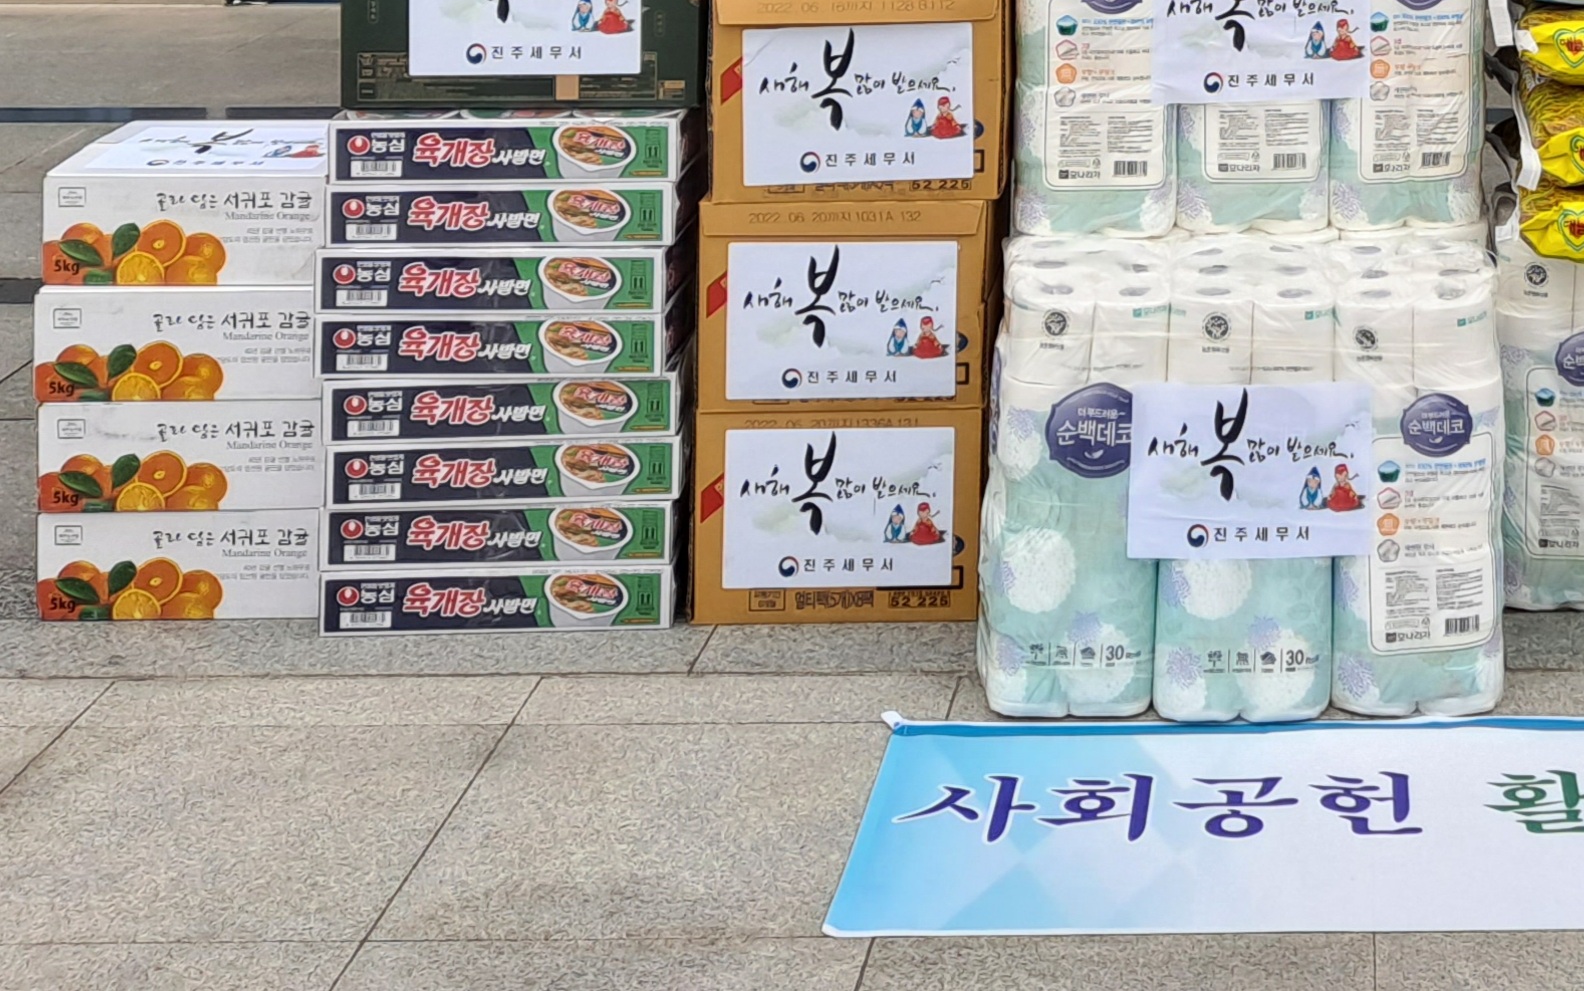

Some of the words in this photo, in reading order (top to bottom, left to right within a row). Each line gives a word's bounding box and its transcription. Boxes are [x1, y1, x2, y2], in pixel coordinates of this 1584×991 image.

[491, 45, 581, 59] 진주세무서
[1228, 72, 1314, 88] 진주세무서
[370, 136, 406, 152] 농심
[411, 131, 495, 168] 육개장
[491, 147, 548, 166] 사발면
[223, 191, 274, 211] 서귀포
[279, 190, 313, 211] 감귤
[365, 200, 401, 216] 농심
[406, 195, 490, 232] 육개장
[486, 211, 543, 230] 사발면
[53, 259, 80, 276] 5kg
[356, 329, 392, 346] 농심
[397, 325, 482, 363] 육개장
[477, 341, 534, 361] 사발면
[367, 395, 404, 412] 농심
[409, 388, 495, 427] 육개장
[491, 403, 549, 423] 사발면
[224, 419, 277, 440] 서귀포
[281, 418, 316, 439] 감귤
[1056, 419, 1132, 447] 순백데코
[1407, 417, 1465, 435] 순백데코
[1146, 424, 1198, 459] 새해
[1200, 387, 1247, 501] 복
[739, 465, 789, 497] 새해
[791, 431, 836, 535] 복
[51, 490, 80, 507] 5kg
[219, 528, 272, 548] 서귀포
[276, 526, 311, 548] 감귤
[1215, 525, 1309, 542] 진주세무서
[804, 556, 893, 572] 진주세무서
[360, 587, 396, 603] 농심
[401, 581, 486, 619] 육개장
[482, 596, 540, 616] 사발면
[48, 596, 77, 613] 5kg
[1105, 645, 1124, 660] 30
[892, 773, 1424, 843] 사회공헌
